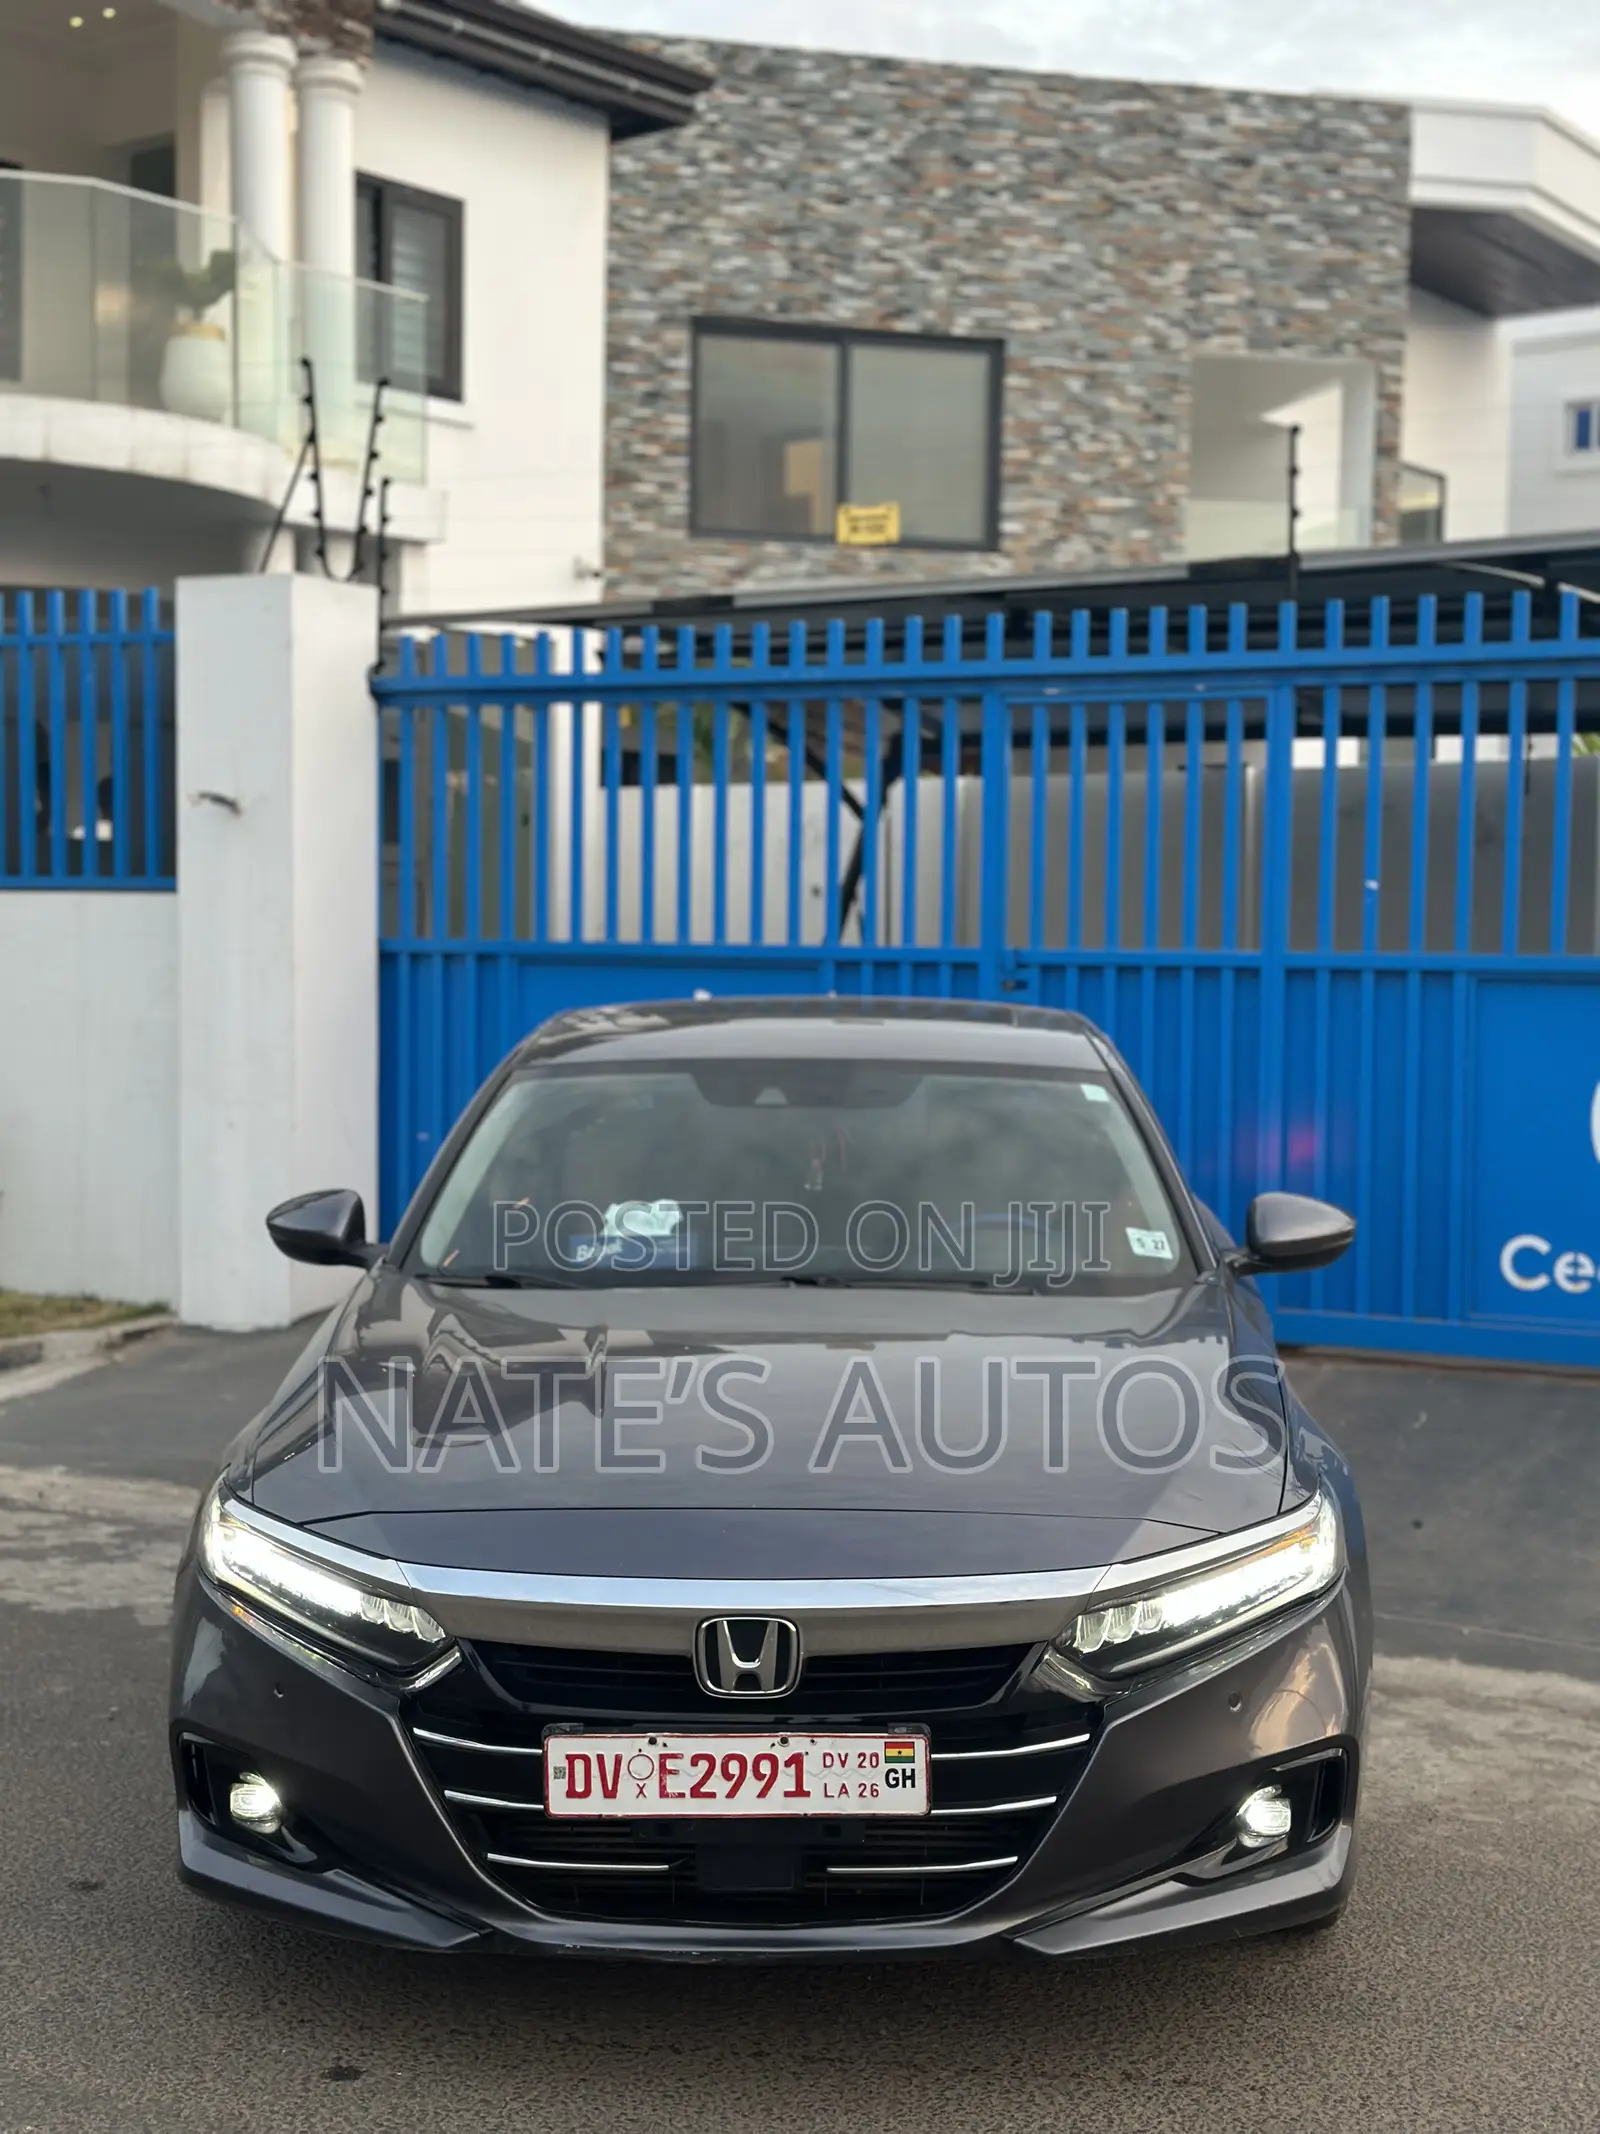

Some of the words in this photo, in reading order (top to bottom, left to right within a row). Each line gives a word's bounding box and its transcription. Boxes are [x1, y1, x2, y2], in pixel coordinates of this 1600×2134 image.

[1500, 1234, 1600, 1293] Ce
[823, 1752, 849, 1768] DV
[857, 1752, 880, 1768] 20
[565, 1753, 623, 1799] DV
[658, 1752, 811, 1799] E2991
[884, 1768, 916, 1789] GH
[823, 1784, 850, 1797] LA
[857, 1783, 880, 1798] 26
